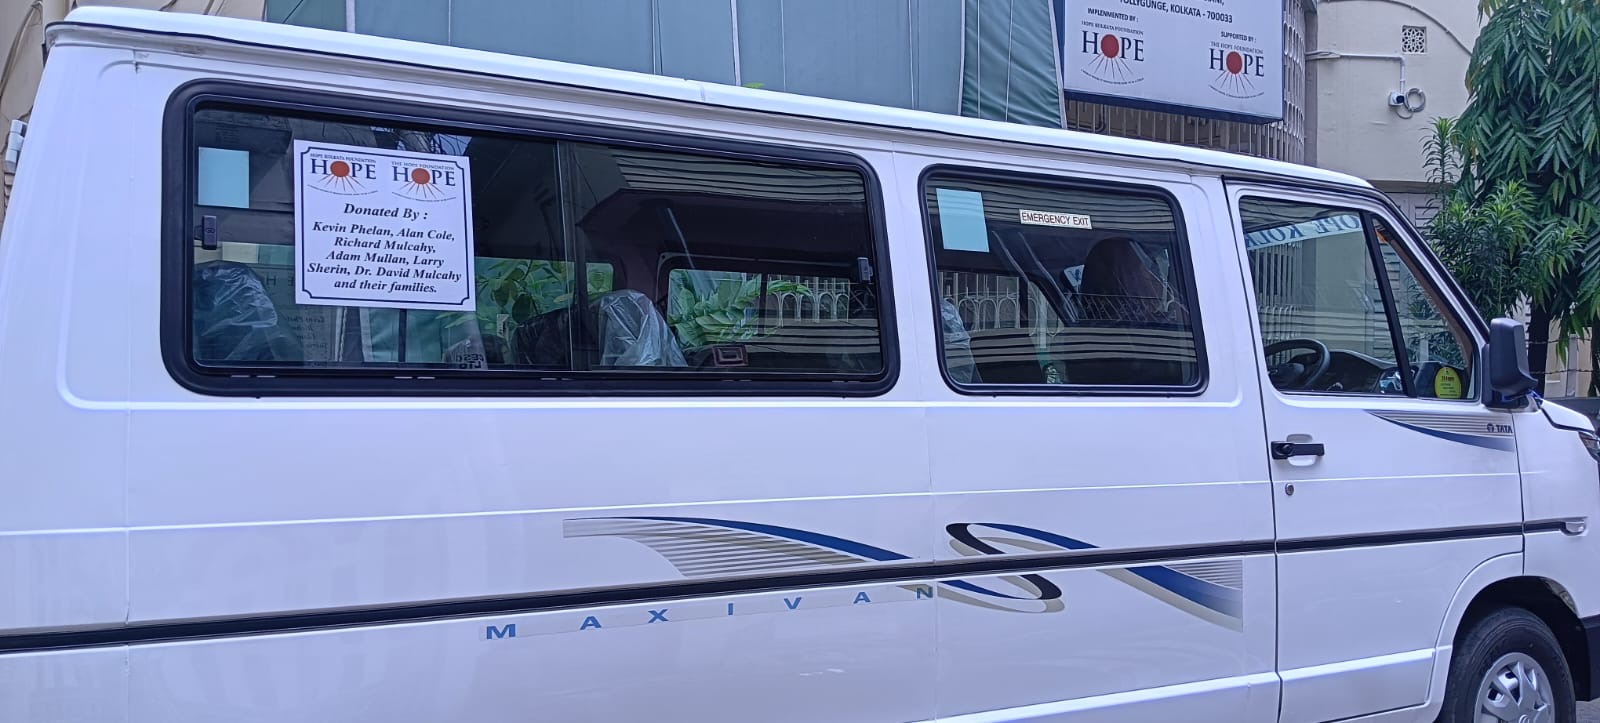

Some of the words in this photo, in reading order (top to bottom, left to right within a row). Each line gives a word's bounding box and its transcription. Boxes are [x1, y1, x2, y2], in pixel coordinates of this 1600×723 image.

[1170, 3, 1201, 18] KOLKATA
[1206, 10, 1233, 24] 700033
[1081, 30, 1144, 62] HOPE
[1209, 47, 1264, 77] HOPE
[310, 158, 377, 180] HOPE
[391, 165, 456, 187] HOPE
[344, 203, 399, 217] Donated
[403, 207, 420, 222] By
[1021, 212, 1071, 225] EMERGENCY
[1072, 216, 1089, 226] EXIT
[312, 221, 347, 233] Kevin
[350, 223, 394, 238] Phelan,
[396, 228, 424, 239] Alan
[427, 229, 455, 241] Cole,
[334, 236, 381, 249] Richard
[384, 240, 436, 254] Mulcahy,
[325, 250, 361, 261] Adam
[364, 252, 410, 266] Mullan,
[413, 255, 445, 269] Larry
[307, 262, 351, 276] Sherin,
[354, 265, 372, 276] Dr.
[376, 266, 411, 278] David
[413, 268, 462, 283] Mulcahy
[334, 279, 357, 289] and
[359, 279, 388, 290] their
[388, 281, 437, 294] families.
[1495, 424, 1514, 434] TATA
